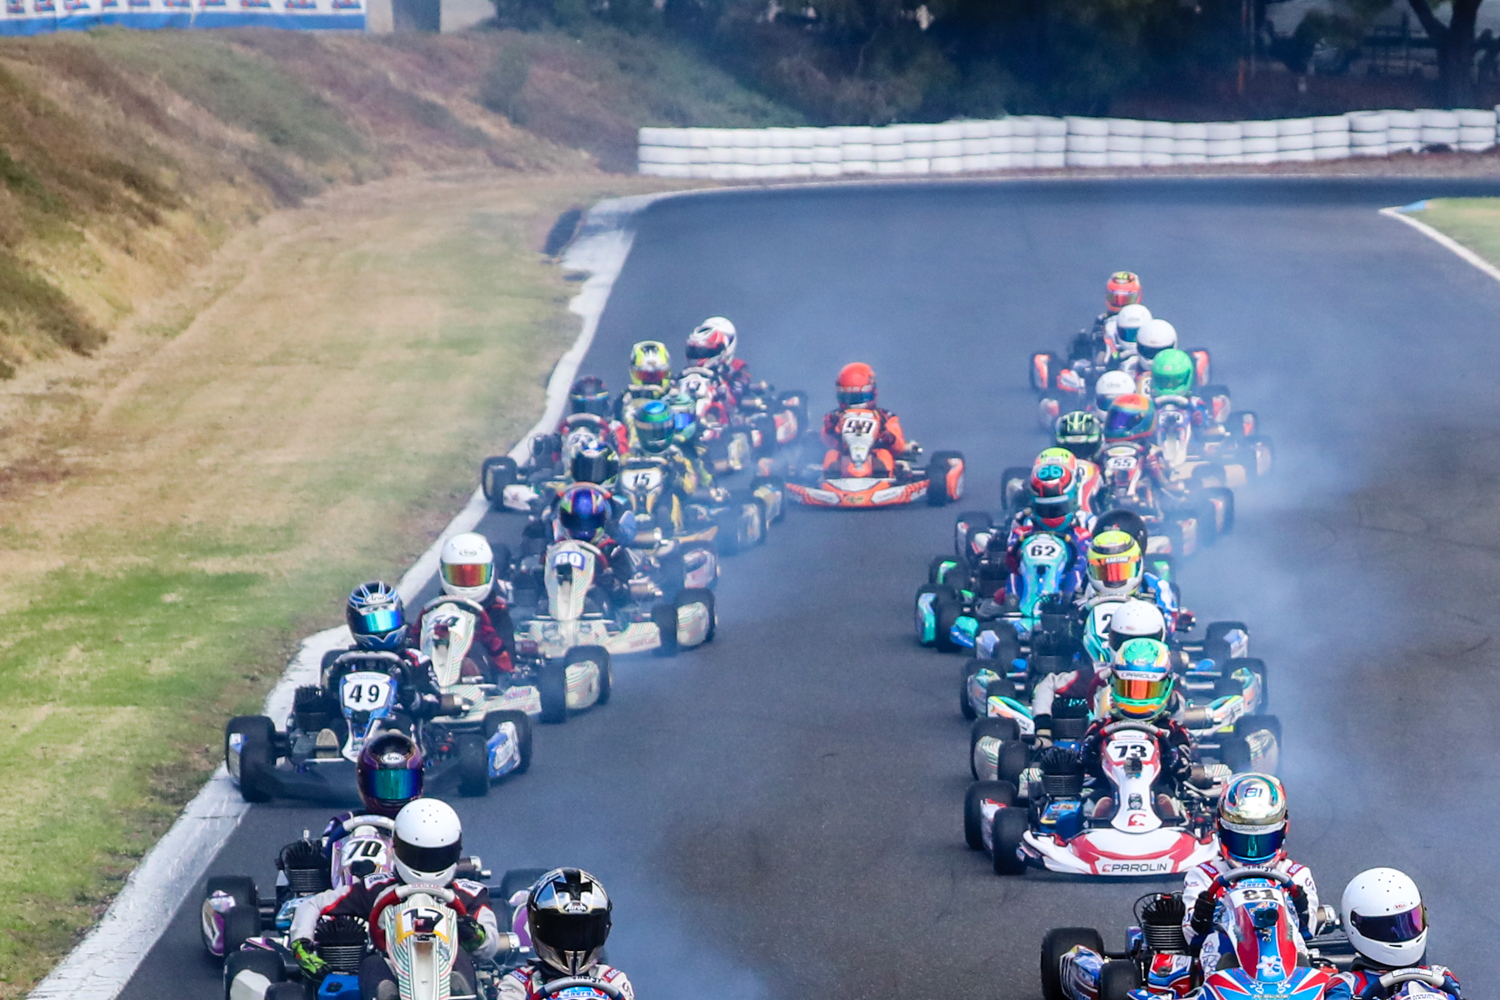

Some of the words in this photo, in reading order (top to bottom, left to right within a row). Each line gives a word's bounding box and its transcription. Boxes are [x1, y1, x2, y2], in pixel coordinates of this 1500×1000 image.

[632, 473, 652, 487] 15
[1031, 545, 1056, 557] 62
[350, 684, 381, 704] 49
[1114, 744, 1148, 759] 73
[347, 840, 383, 861] 70
[1242, 889, 1279, 902] 81
